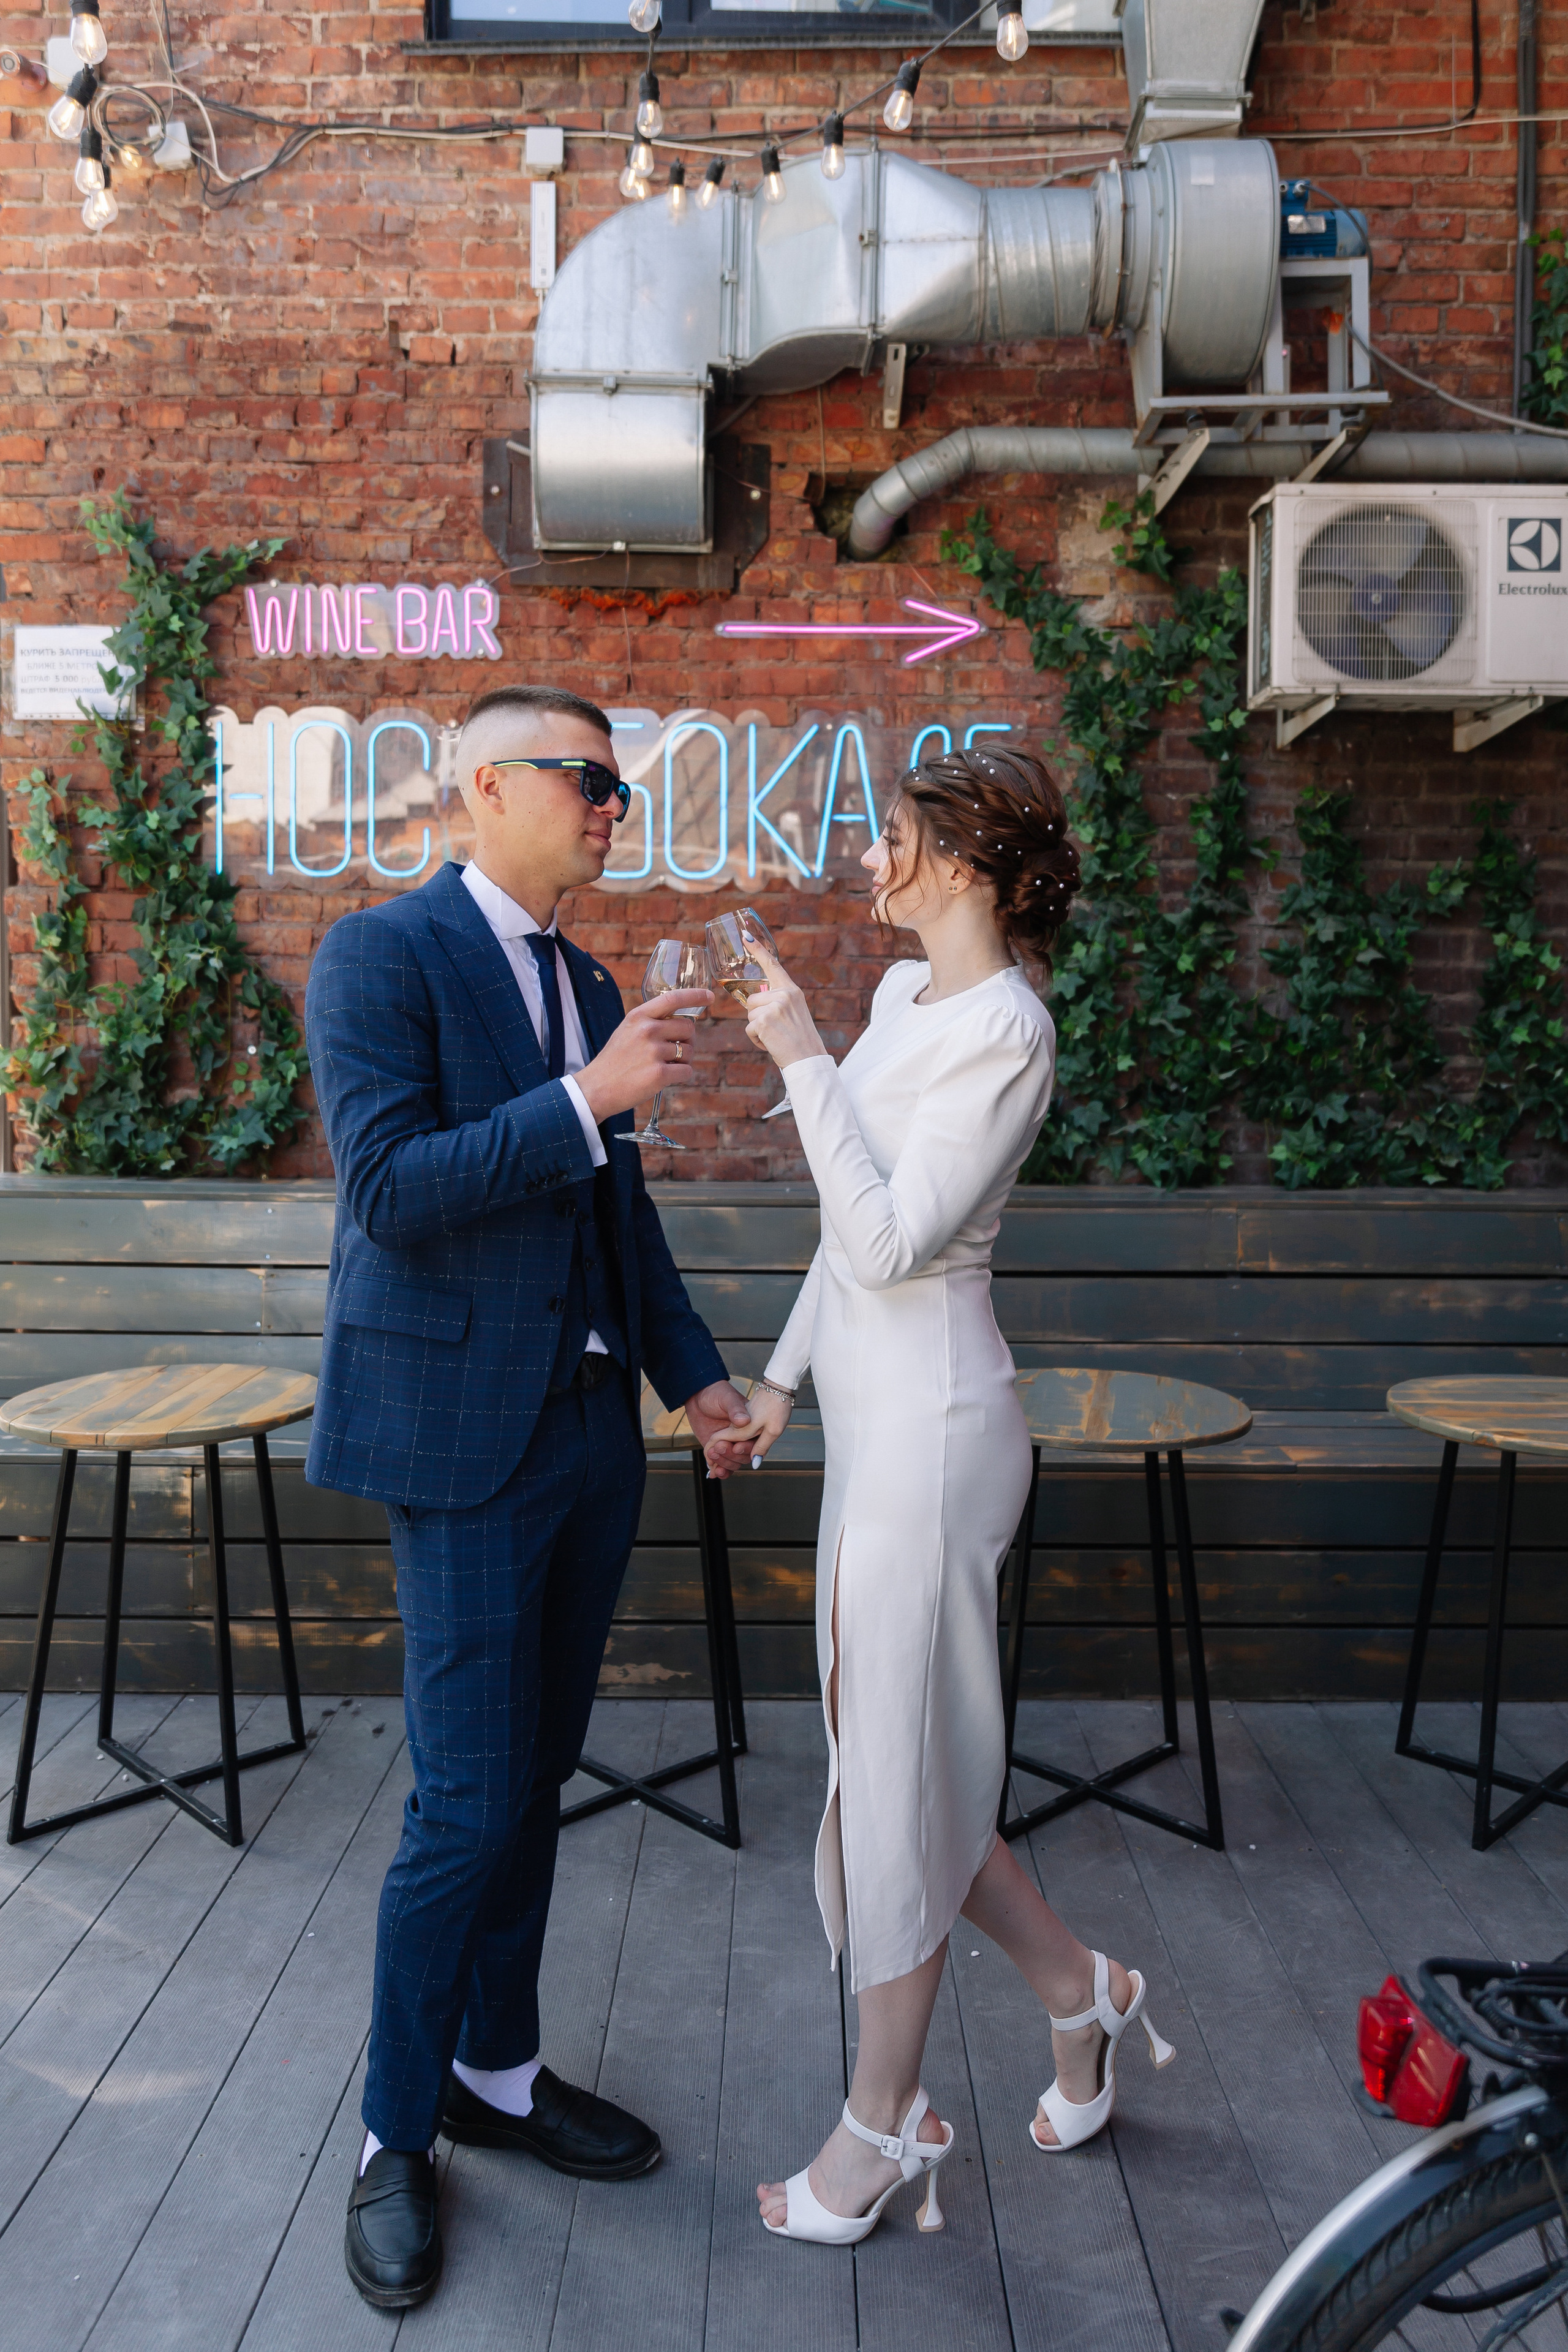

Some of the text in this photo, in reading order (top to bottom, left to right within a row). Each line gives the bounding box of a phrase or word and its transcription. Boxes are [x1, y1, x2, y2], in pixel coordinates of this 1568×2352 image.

[1498, 583, 1568, 595] Electrolux
[249, 587, 497, 654] WINE BAR
[59, 648, 115, 658] ЗАПРЕЩЕН
[81, 676, 103, 685] рубл
[216, 720, 1012, 879] НОС ОКА
